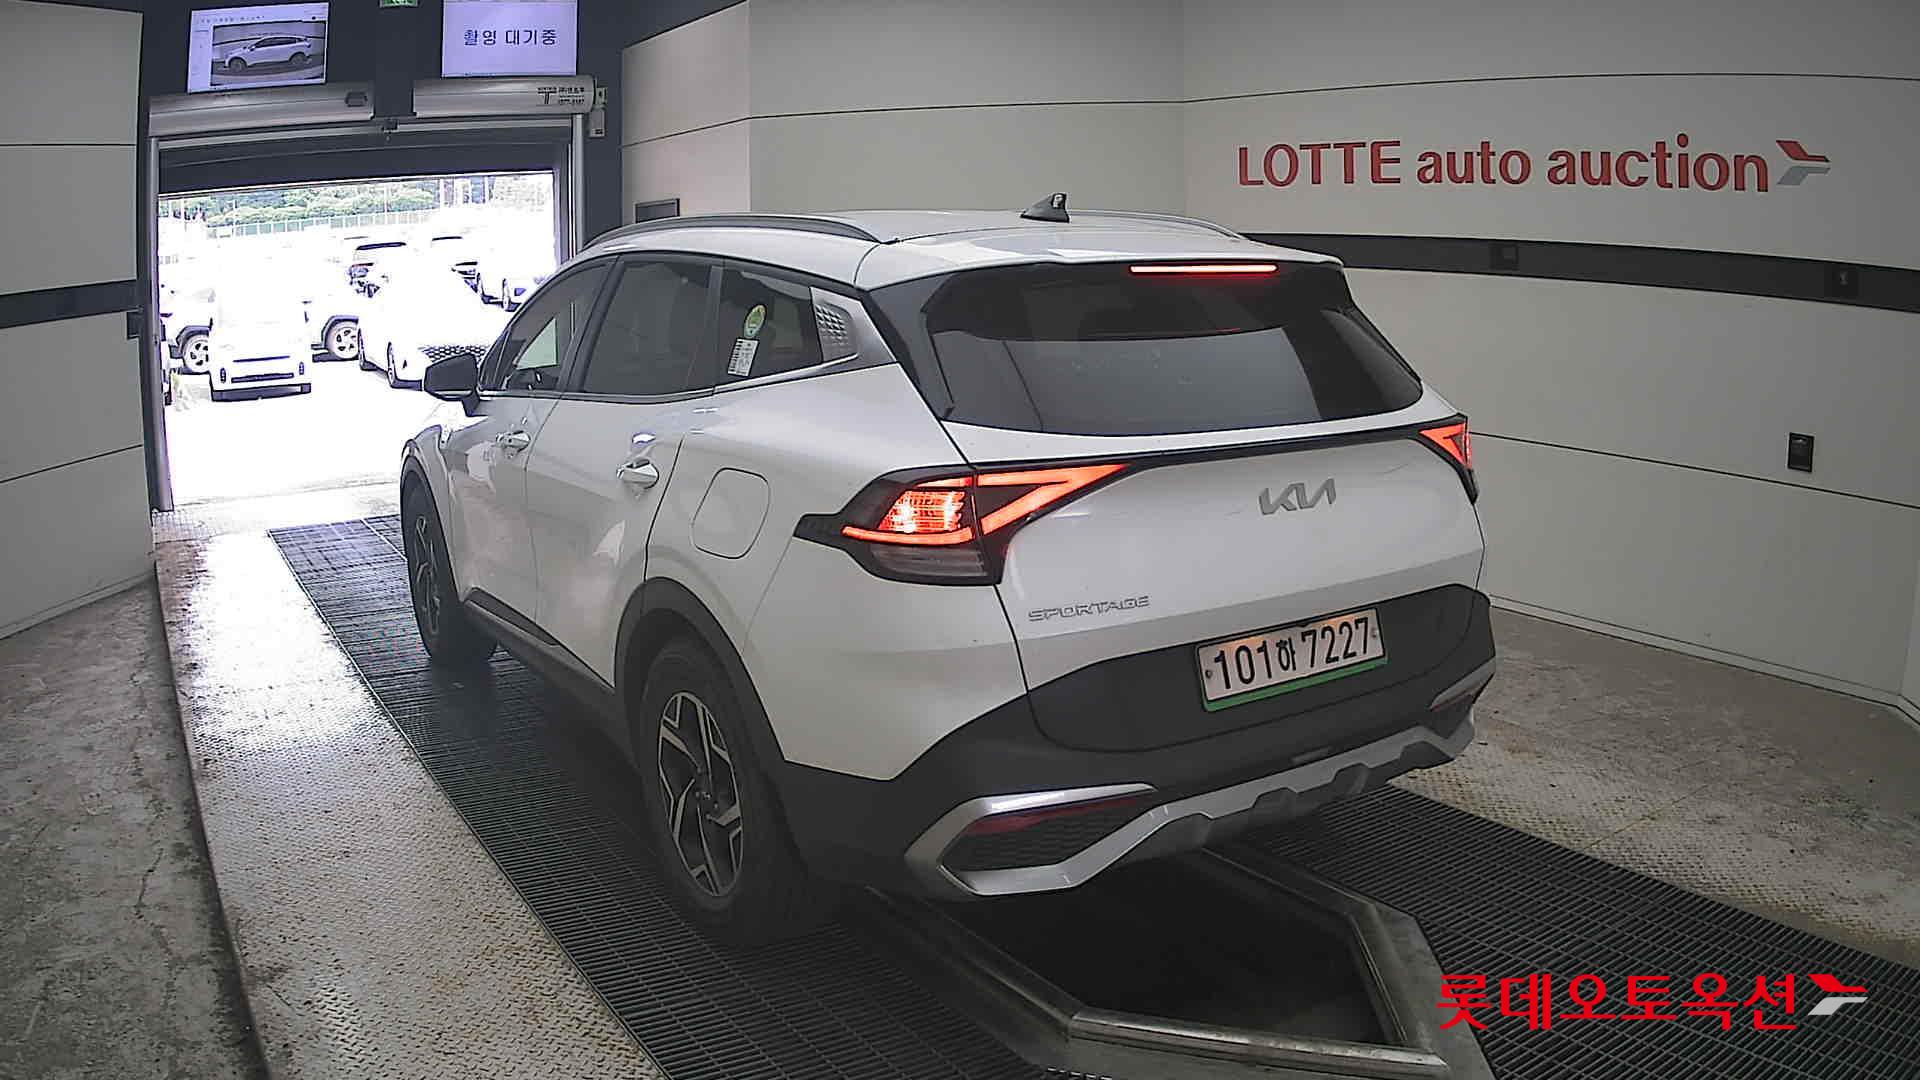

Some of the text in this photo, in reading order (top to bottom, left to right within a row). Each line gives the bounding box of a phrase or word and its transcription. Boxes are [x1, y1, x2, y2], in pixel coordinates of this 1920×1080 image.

[505, 29, 557, 46] 대기중
[1239, 134, 1769, 191] LOTTE auto auction
[1028, 595, 1149, 622] SPORTAGE
[1214, 616, 1369, 690] 101하 7227
